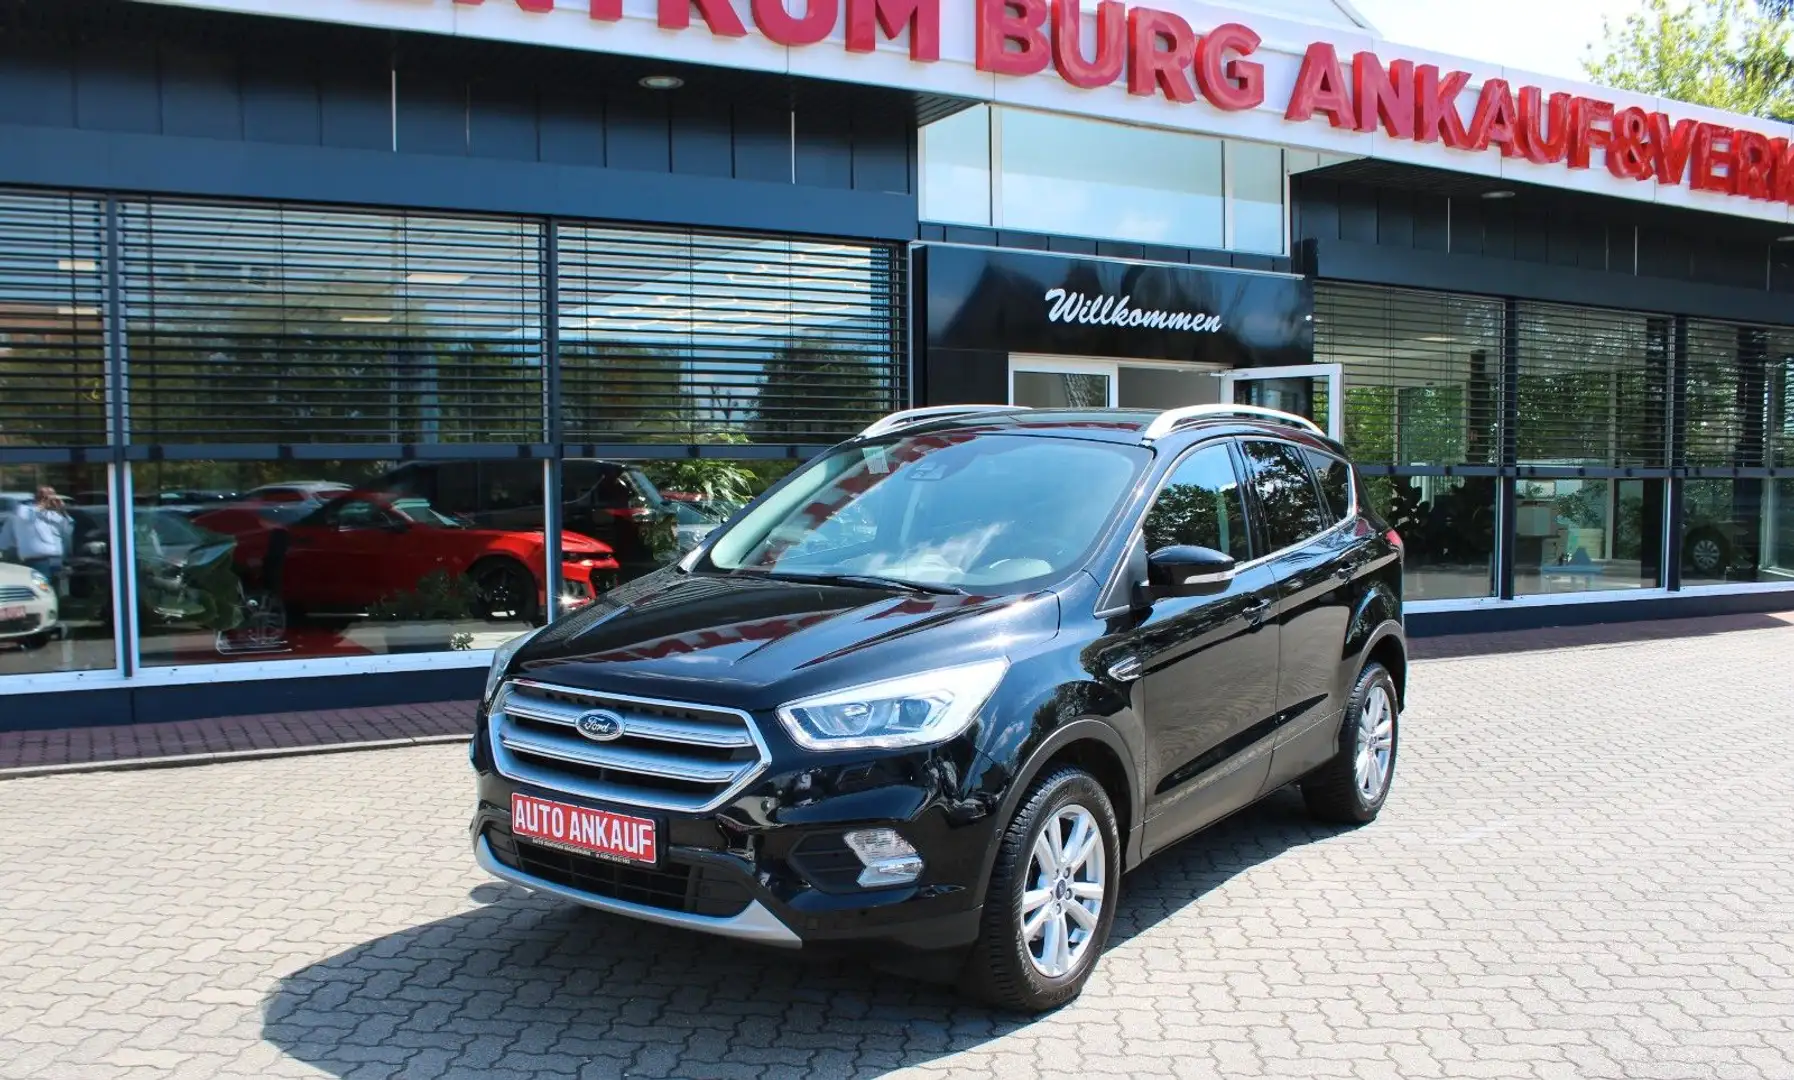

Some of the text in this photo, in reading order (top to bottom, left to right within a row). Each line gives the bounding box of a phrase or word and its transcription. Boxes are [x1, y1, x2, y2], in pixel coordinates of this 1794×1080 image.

[976, 0, 1264, 111] BURG
[1045, 288, 1222, 333] Willkommen
[583, 714, 610, 733] Ford
[514, 799, 564, 838] AUTO
[569, 810, 653, 856] ANKAUF
